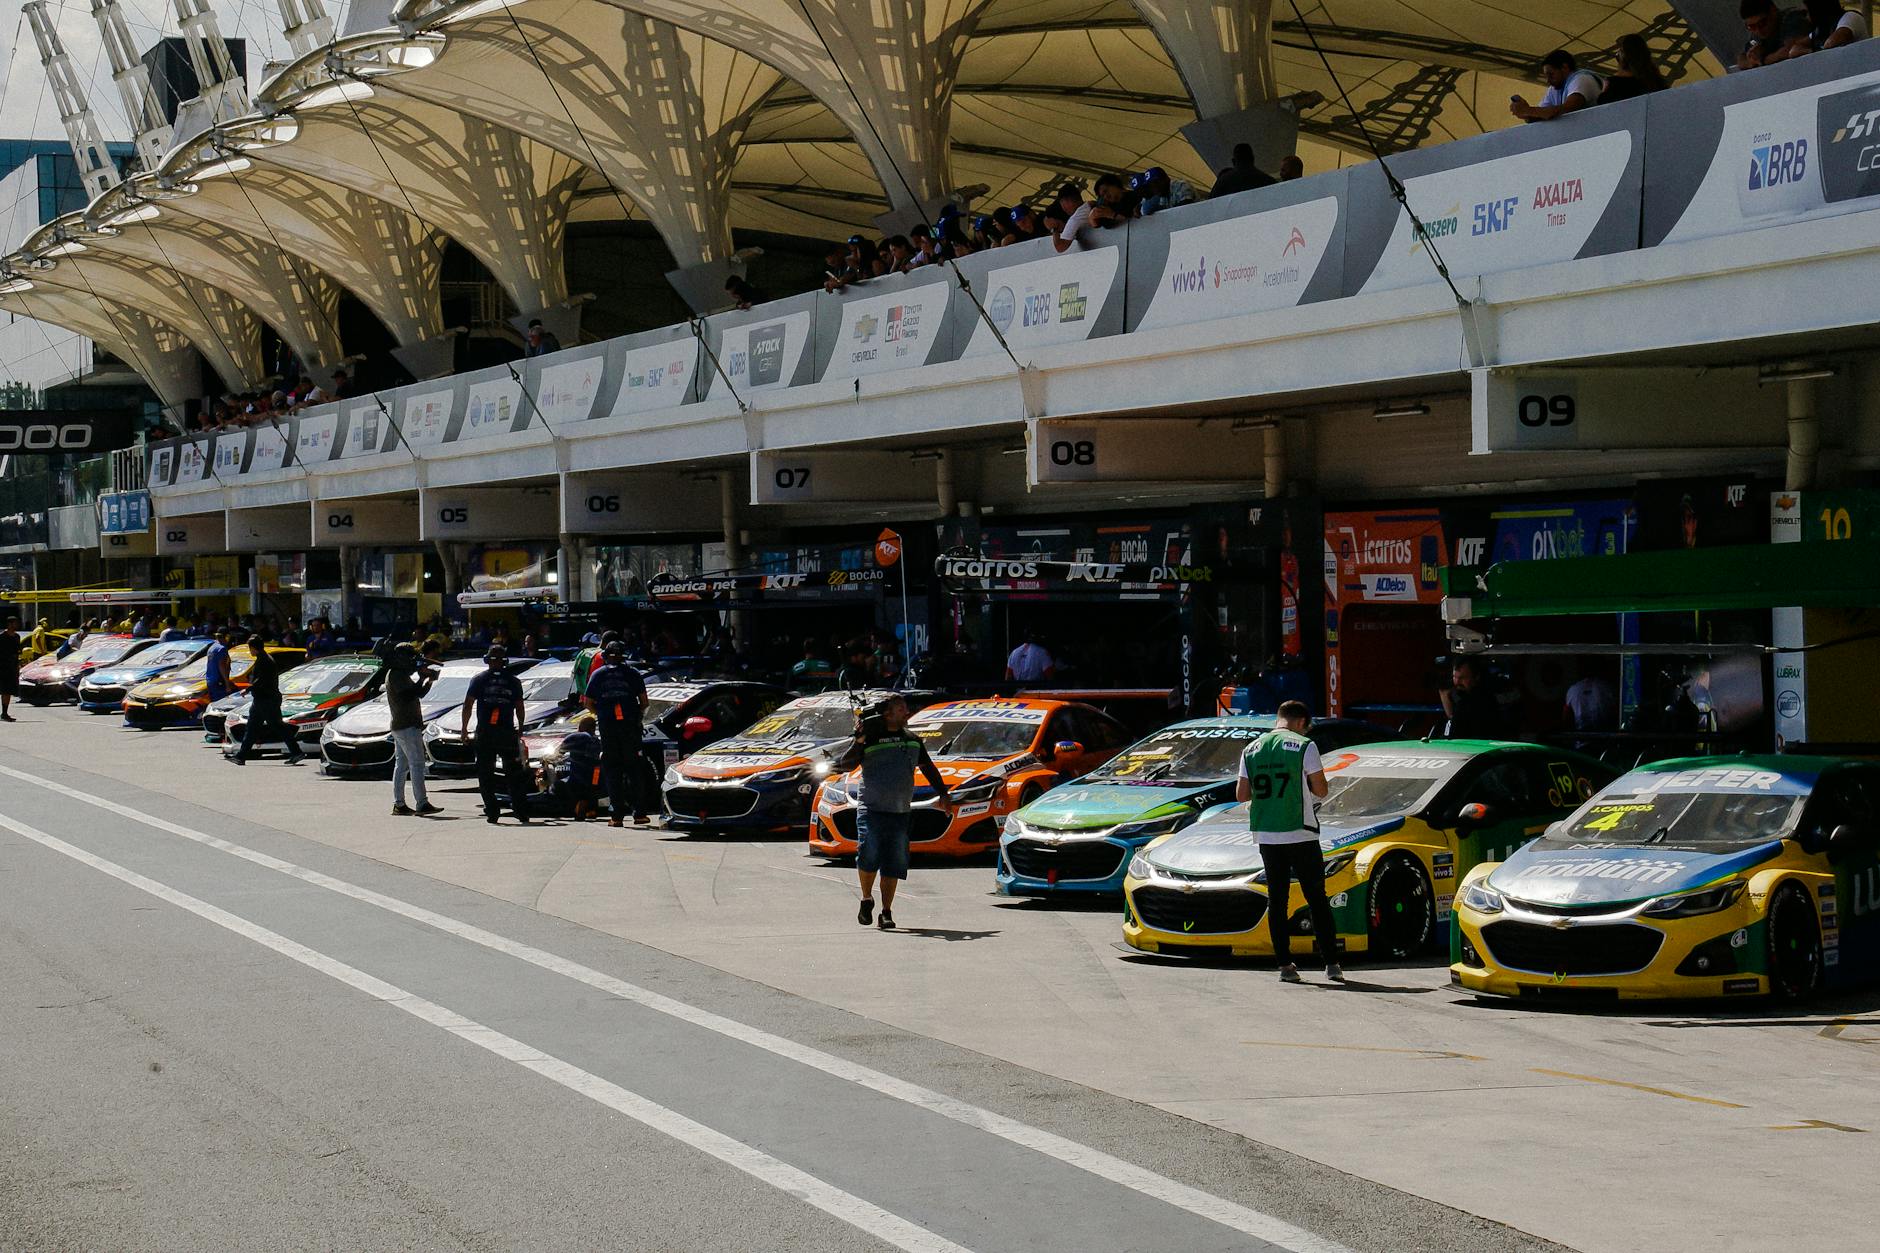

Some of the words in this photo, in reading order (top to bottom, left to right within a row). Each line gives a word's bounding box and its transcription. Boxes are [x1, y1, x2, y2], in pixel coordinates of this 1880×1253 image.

[1846, 109, 1880, 140] ST
[1768, 138, 1808, 187] BRB
[1533, 178, 1584, 210] AXALTA
[1472, 196, 1519, 237] SKF
[1547, 213, 1567, 228] Tintas
[1172, 263, 1197, 294] vivo
[752, 337, 782, 357] STOCK
[1518, 394, 1576, 427] 09
[1050, 440, 1096, 466] 08
[775, 468, 811, 489] 07
[587, 495, 620, 513] 06
[1727, 484, 1746, 508] KTF
[328, 514, 354, 529] 04
[439, 508, 468, 523] 05
[1771, 517, 1800, 526] CHEVROLET
[1818, 506, 1853, 541] 10
[110, 535, 129, 546] 01
[166, 530, 188, 543] 02
[1121, 534, 1148, 563] BOCÃO
[1363, 529, 1412, 565] icarros
[1456, 537, 1487, 567] KTF
[849, 567, 884, 581] BOCÃO
[944, 561, 1039, 578] icarros
[1149, 564, 1214, 583] pixbet
[764, 573, 808, 591] KTF
[1375, 577, 1407, 593] ACDelco
[922, 709, 1043, 720] ACDelco
[1358, 758, 1450, 769] BETANO
[1253, 772, 1291, 801] 97
[1557, 774, 1573, 793] 19
[1631, 770, 1783, 795] JEFER
[1589, 803, 1656, 813] J.CAMPOS
[1583, 811, 1625, 832] 4
